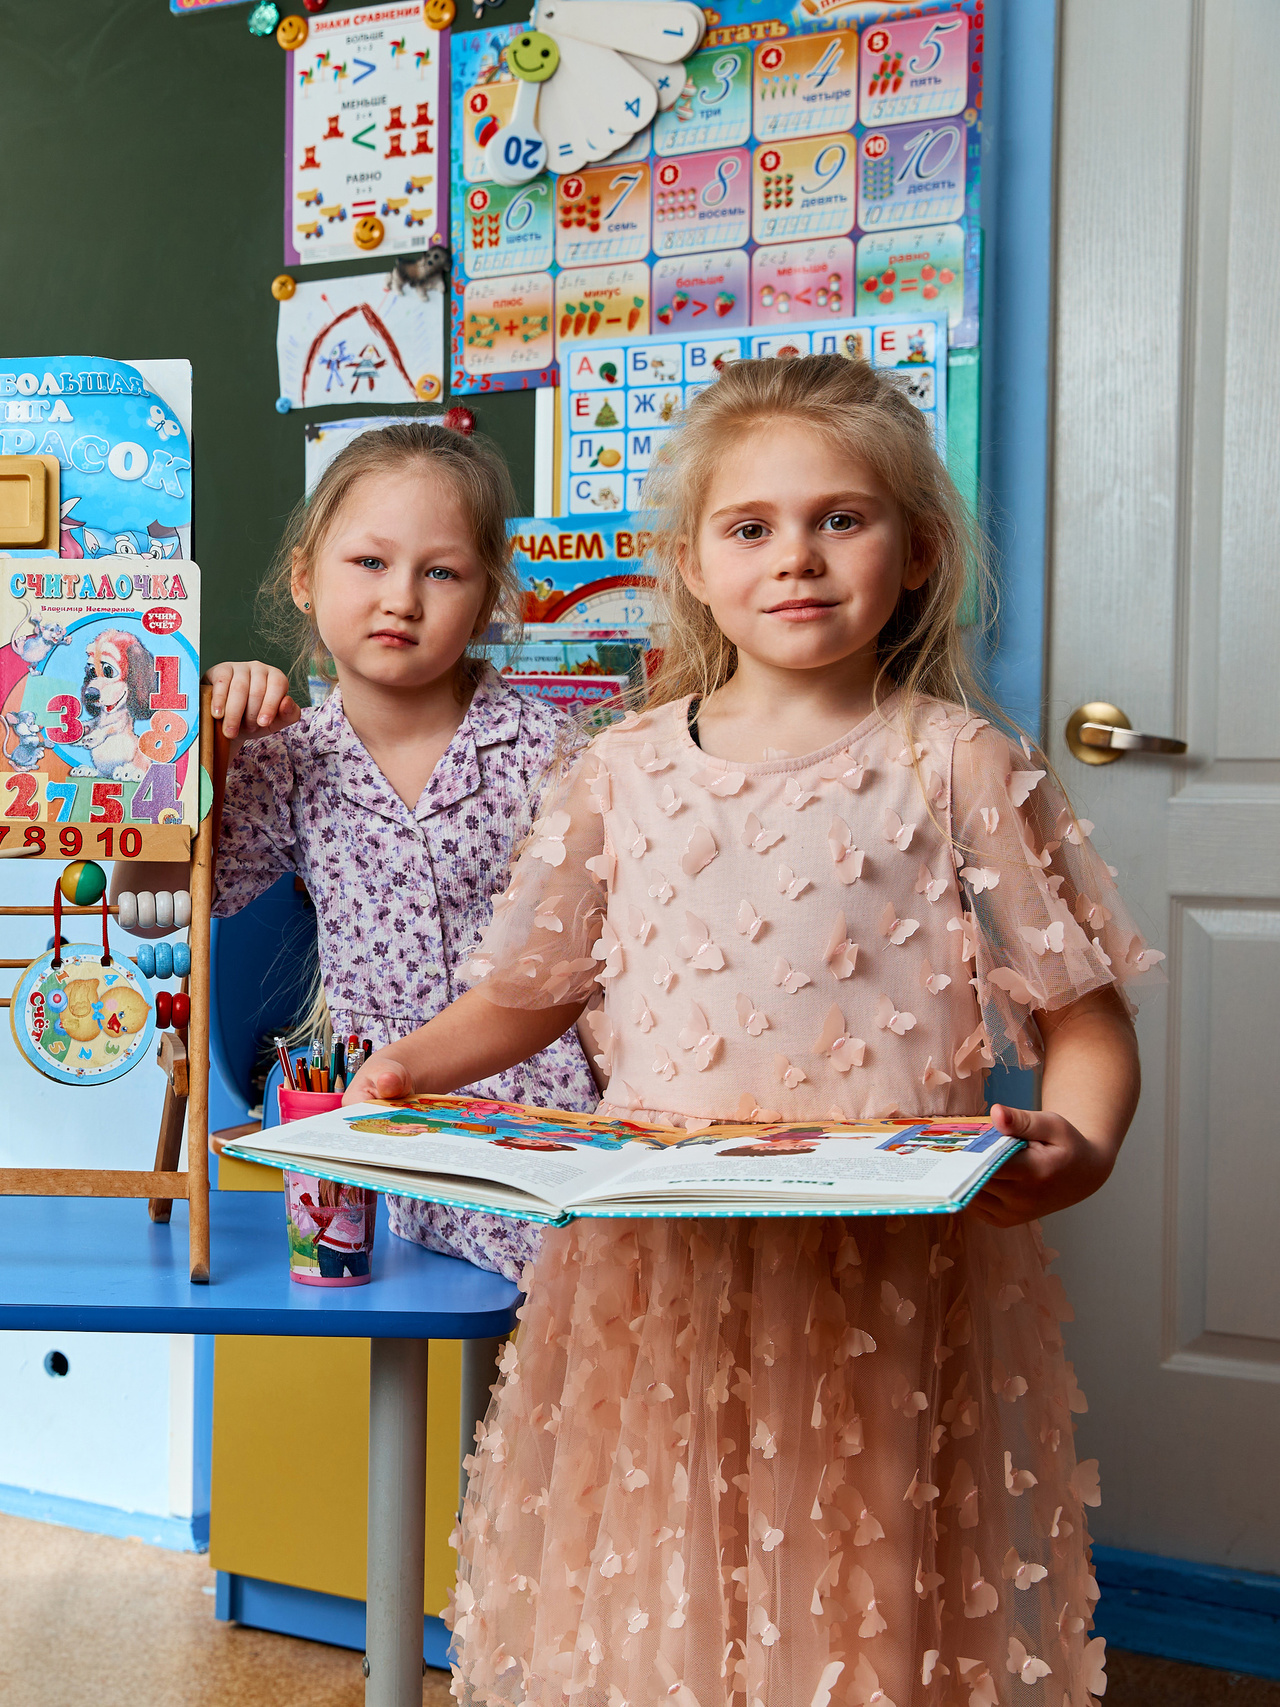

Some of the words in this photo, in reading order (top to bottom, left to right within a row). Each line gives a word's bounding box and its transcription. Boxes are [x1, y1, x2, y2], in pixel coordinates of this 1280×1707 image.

[314, 16, 350, 33] ЗНАКИ
[353, 6, 421, 27] СРАВНЕНИЯ
[907, 18, 963, 75] 5
[803, 37, 846, 90] 4
[698, 53, 742, 104] 3
[910, 77, 942, 89] пять
[341, 96, 387, 110] МЕНЬШЕ
[802, 89, 852, 104] четыре
[624, 97, 641, 118] 4
[700, 108, 722, 121] три
[504, 136, 543, 169] 20
[895, 125, 961, 184] 10
[346, 171, 382, 185] РАВНО
[800, 142, 848, 195] 9
[701, 156, 741, 207] 8
[906, 180, 956, 195] десять
[603, 170, 643, 222] 7
[800, 193, 848, 209] девять
[504, 182, 547, 232] 6
[698, 207, 746, 220] восемь
[607, 222, 638, 233] семь
[506, 231, 542, 244] шесть
[888, 251, 931, 266] равно
[776, 262, 828, 277] меньше
[676, 274, 725, 288] больше
[583, 287, 621, 299] минус
[493, 297, 523, 309] плюс
[881, 331, 896, 351] Е
[577, 357, 594, 375] А
[633, 352, 648, 371] Б
[691, 347, 706, 367] В
[576, 393, 591, 417] Ё
[634, 393, 656, 413] Ж
[577, 439, 592, 458] Л
[633, 436, 651, 455] М
[576, 481, 591, 499] С
[10, 573, 188, 599] СЧИТАЛОЧКА
[41, 605, 83, 614] Владимир
[86, 605, 136, 614] Нестеренко
[148, 613, 177, 621] УЧИМ
[149, 620, 175, 629] СЧЁТ
[150, 656, 188, 711] 1
[46, 695, 83, 744] 3
[138, 710, 188, 763] 8
[4, 773, 40, 821] 2
[45, 781, 78, 823] 7
[90, 783, 124, 824] 5
[132, 763, 183, 825] 4
[23, 826, 47, 856] 8
[59, 826, 83, 857] 9
[96, 827, 143, 857] 10
[104, 974, 119, 987] 4
[29, 991, 50, 1043] Счёт
[48, 1041, 66, 1054] 5
[78, 1047, 93, 1060] 2
[105, 1040, 121, 1055] 3
